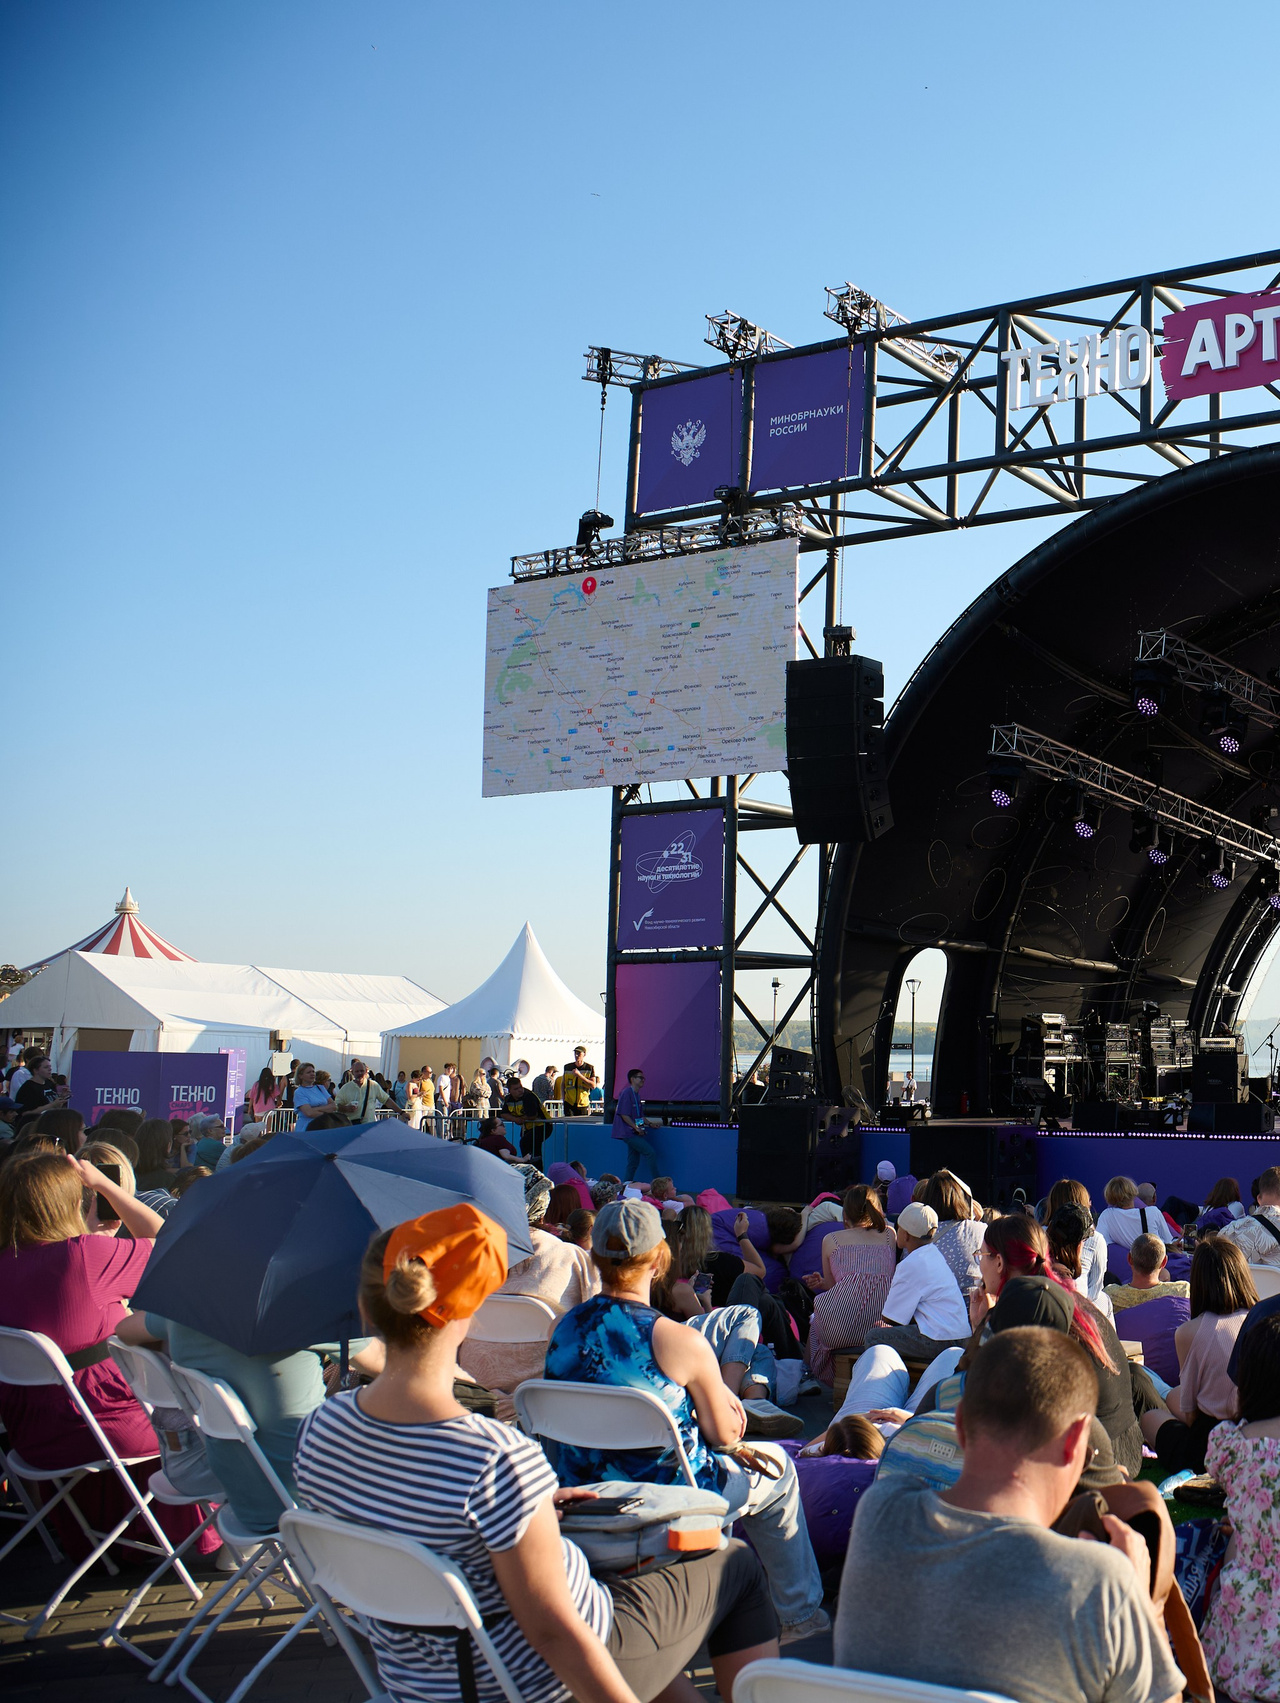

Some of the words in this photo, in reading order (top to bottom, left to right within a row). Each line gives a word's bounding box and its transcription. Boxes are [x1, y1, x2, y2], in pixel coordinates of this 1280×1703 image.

[1001, 325, 1152, 411] ТЕХНО
[770, 404, 844, 426] МИНОБРНАУКИ
[769, 422, 808, 437] РОССИИ
[670, 843, 684, 854] 22
[95, 1087, 140, 1104] ТЕХНО
[171, 1085, 216, 1102] ТЕХНО
